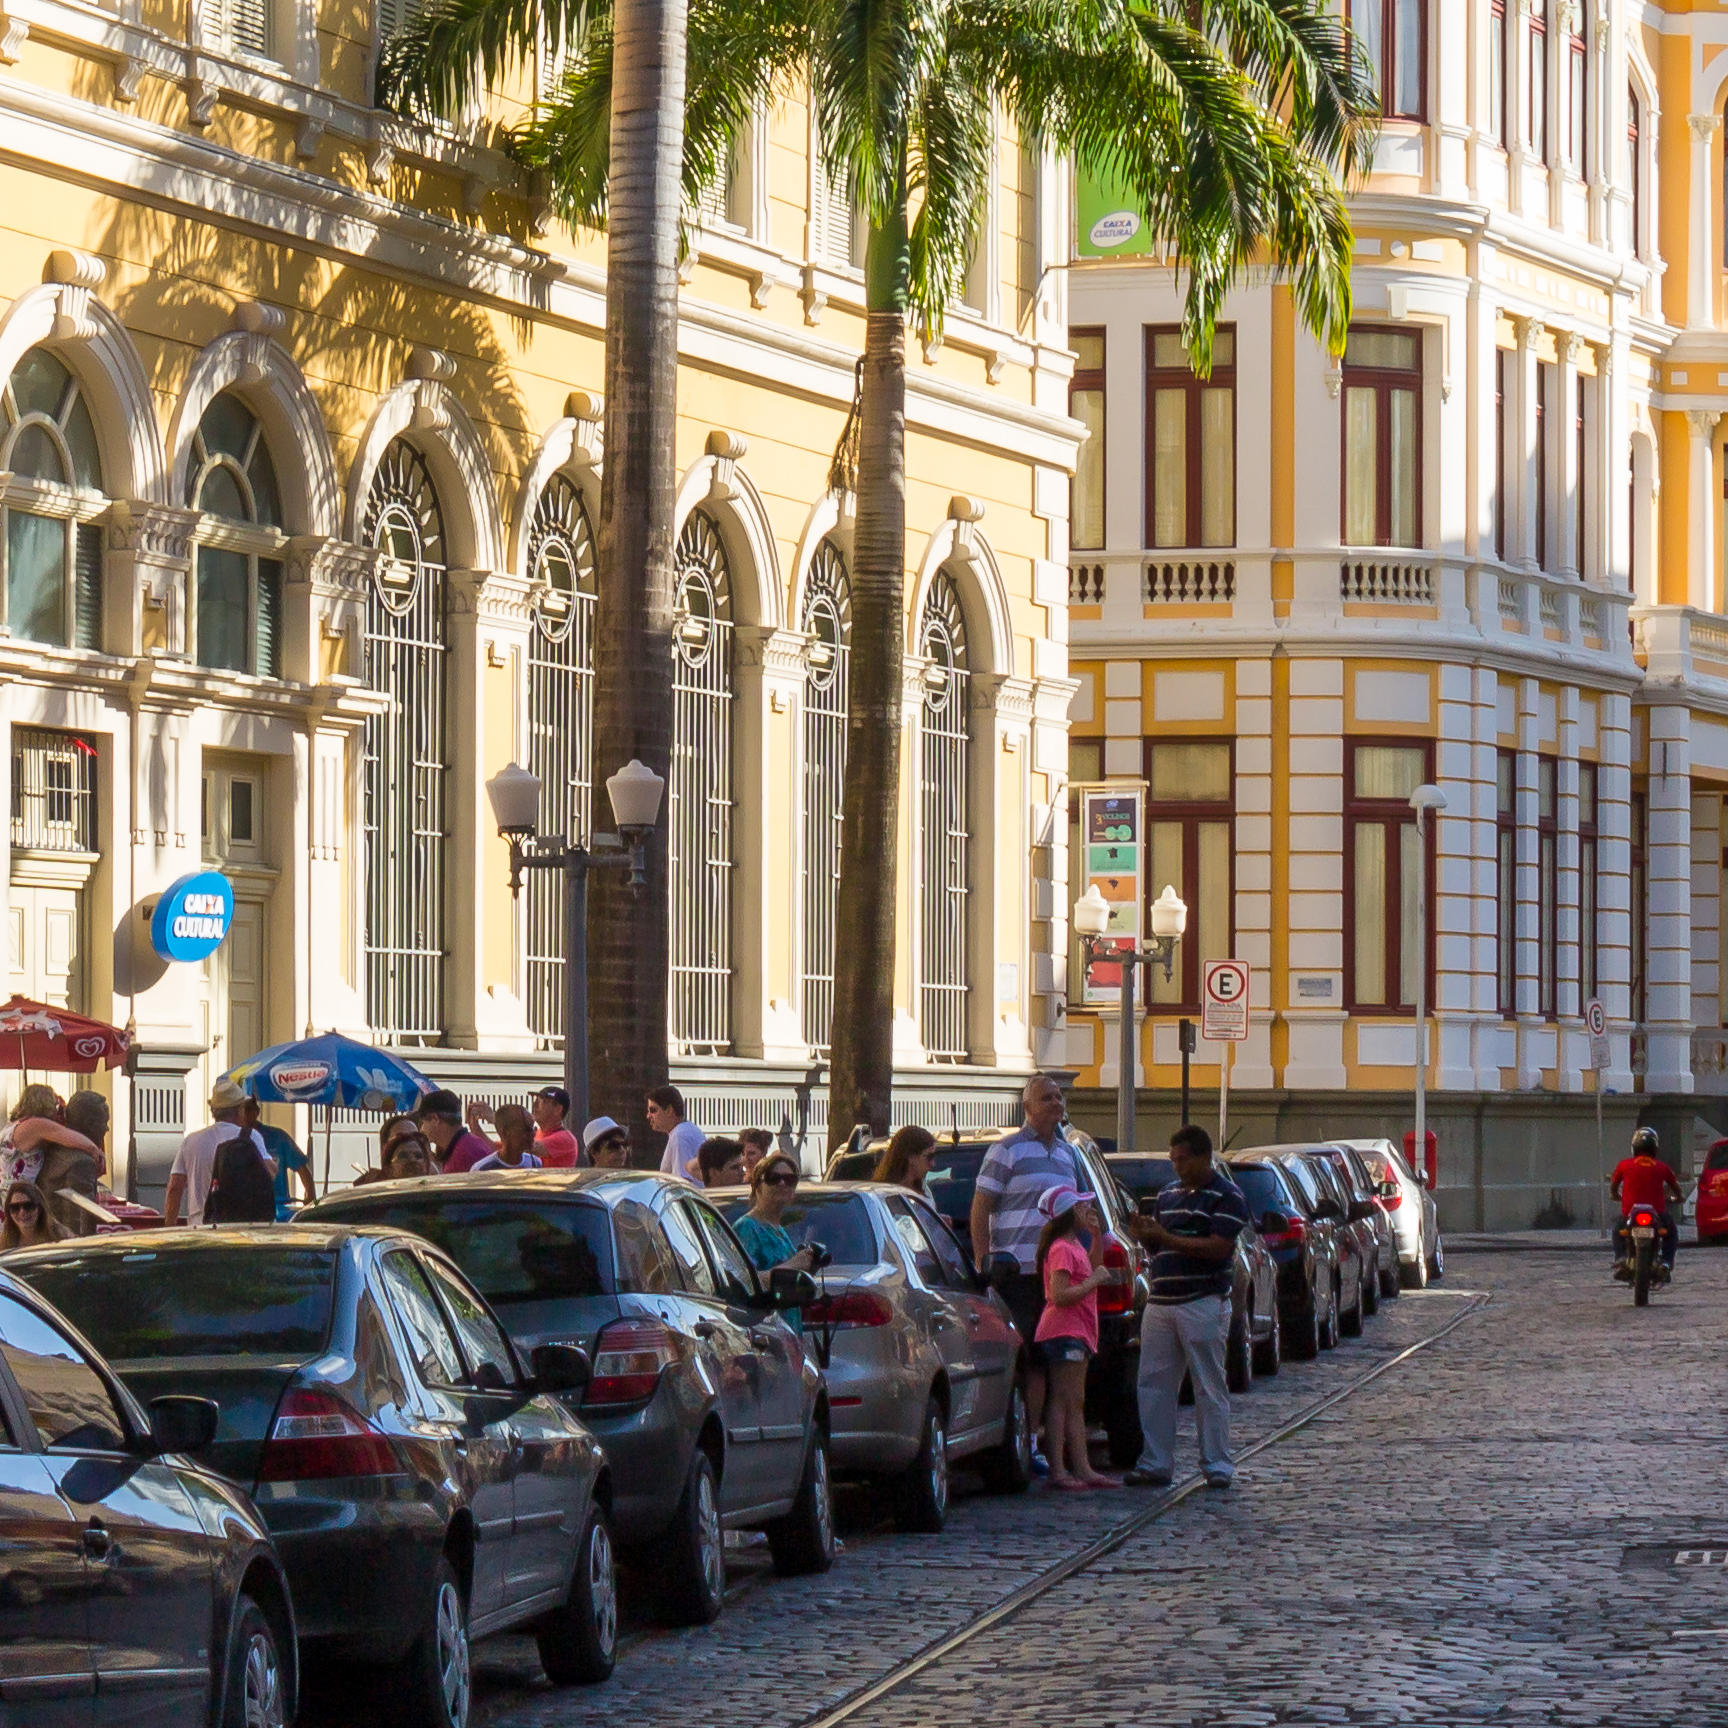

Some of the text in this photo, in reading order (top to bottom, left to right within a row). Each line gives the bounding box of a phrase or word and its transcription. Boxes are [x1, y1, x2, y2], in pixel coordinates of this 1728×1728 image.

[1104, 220, 1131, 228] CAIXA
[183, 893, 225, 915] CAIXA
[173, 915, 225, 939] CULTURAL
[1219, 973, 1233, 995] E
